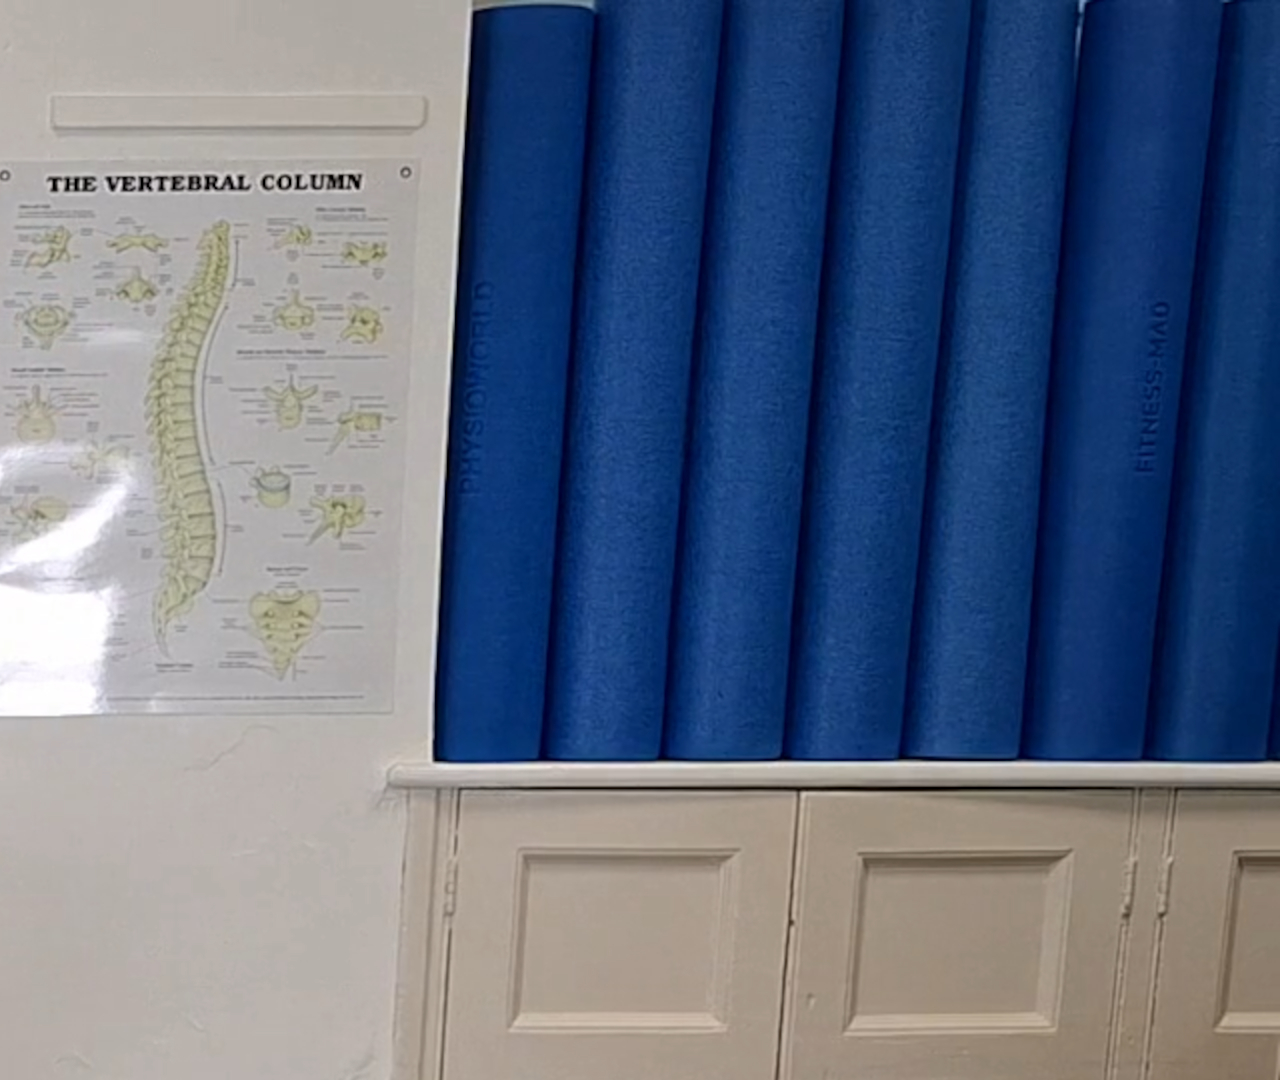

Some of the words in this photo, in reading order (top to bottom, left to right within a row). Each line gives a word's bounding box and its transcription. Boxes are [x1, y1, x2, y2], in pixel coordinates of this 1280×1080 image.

[46, 176, 97, 192] THE
[105, 174, 252, 192] VERTEBRAL
[261, 173, 362, 191] COLUMN
[460, 280, 494, 496] PHYSIOWORLD
